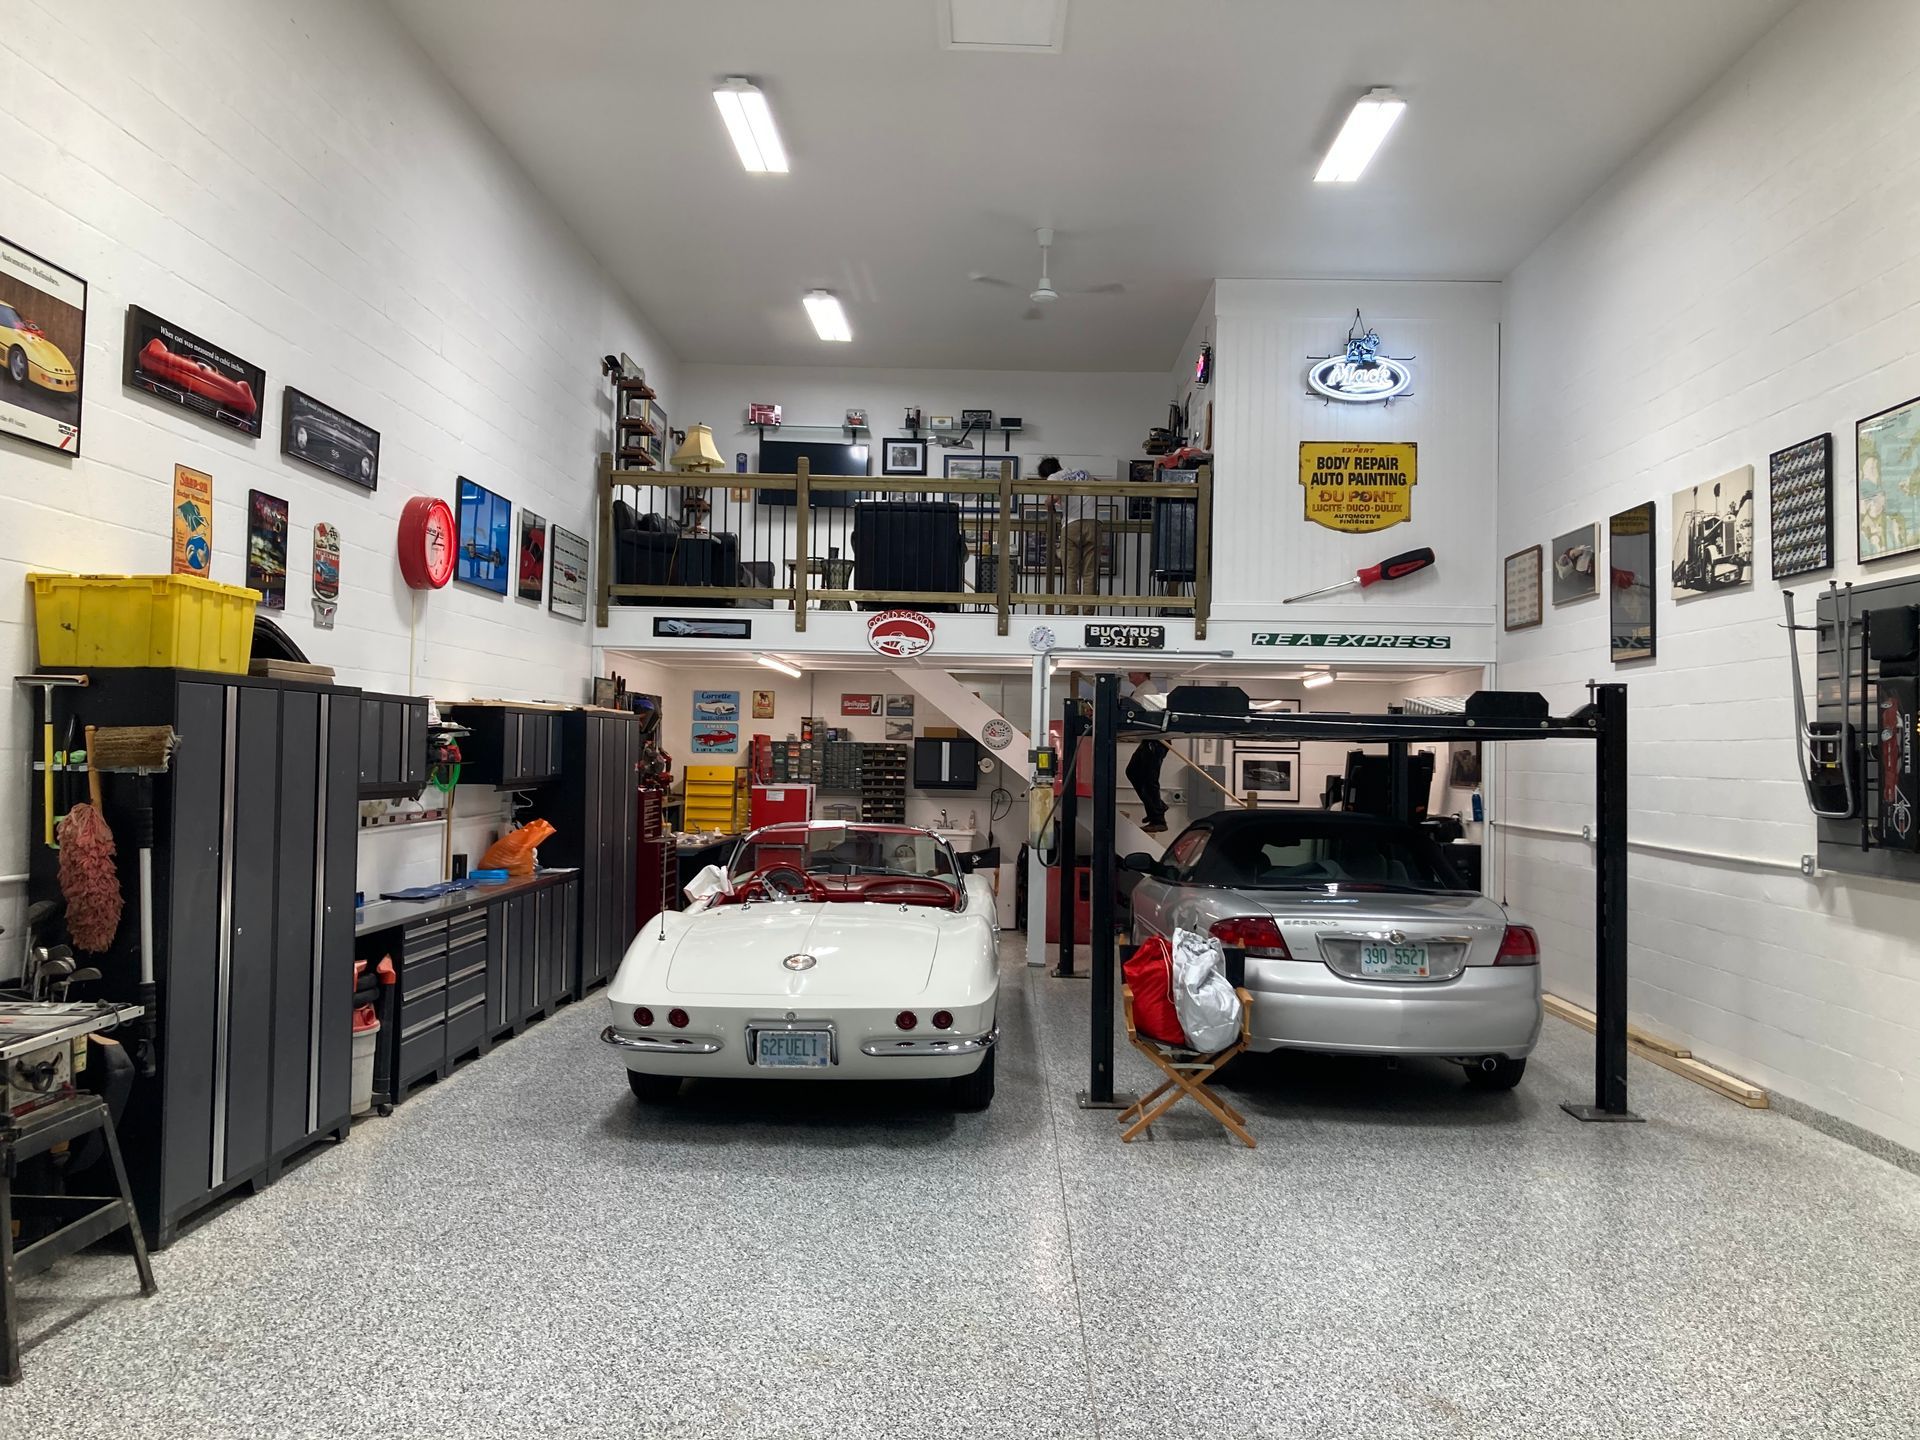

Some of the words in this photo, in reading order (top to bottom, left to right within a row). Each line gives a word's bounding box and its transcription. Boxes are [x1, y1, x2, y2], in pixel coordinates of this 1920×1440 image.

[160, 326, 174, 339] When
[184, 340, 194, 349] was
[193, 344, 215, 360] measured
[1324, 360, 1394, 389] Mack
[1316, 456, 1351, 470] BODY
[1354, 456, 1399, 470] REPAIR
[1310, 472, 1344, 486] AUTO
[1348, 472, 1407, 486] PAINTING
[1348, 490, 1397, 503] PONT
[1312, 504, 1343, 513] LUCITE
[1346, 504, 1371, 513] DUCO
[1374, 504, 1403, 513] DULUX
[868, 611, 898, 628] OOOLD
[900, 611, 933, 630] SCHOOL
[1090, 626, 1160, 640] BUCYRUS
[1100, 637, 1150, 647] ERIE
[1323, 634, 1449, 648] EXPRESS
[701, 691, 732, 700] Corvette
[984, 721, 1011, 734] CHEVROLET
[1364, 948, 1388, 964] 390
[1394, 948, 1425, 966] 5527
